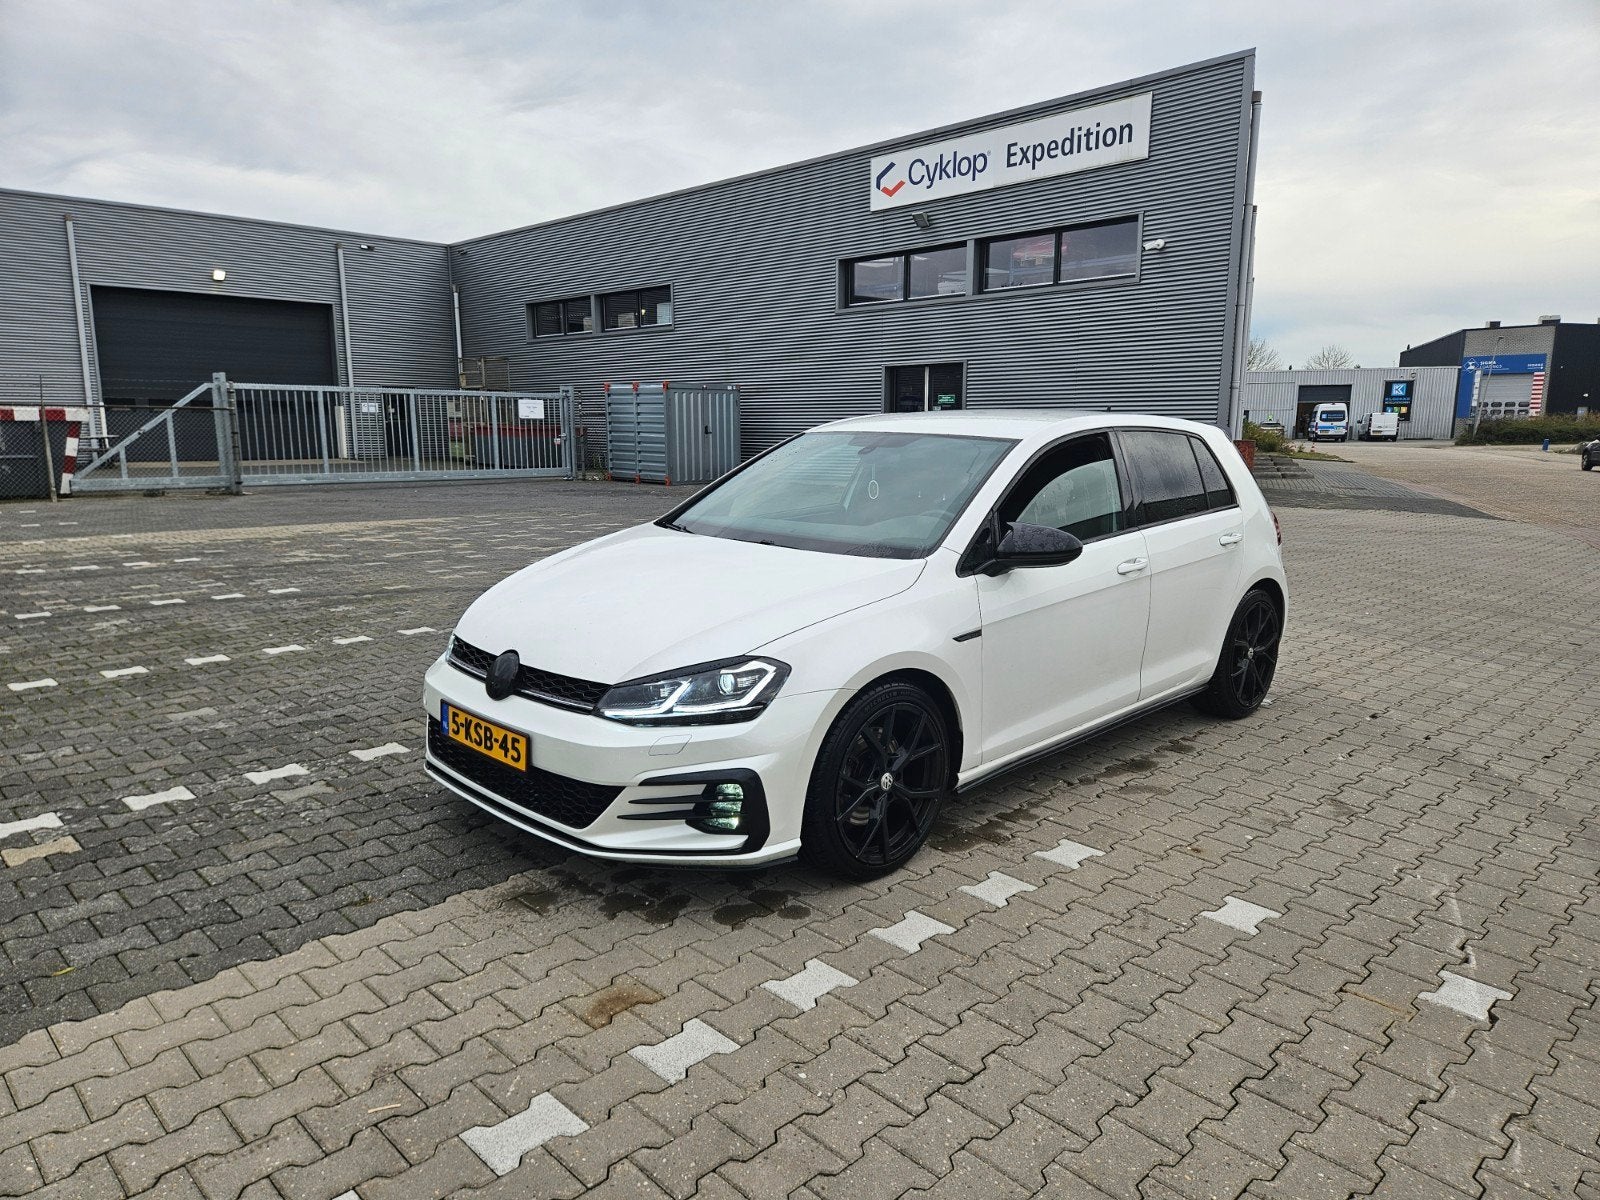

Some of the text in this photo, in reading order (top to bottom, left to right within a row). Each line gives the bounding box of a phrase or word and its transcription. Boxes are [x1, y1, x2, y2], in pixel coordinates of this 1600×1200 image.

[908, 122, 1134, 189] Cyklop Expedition
[451, 710, 521, 763] 5-KSB-45
